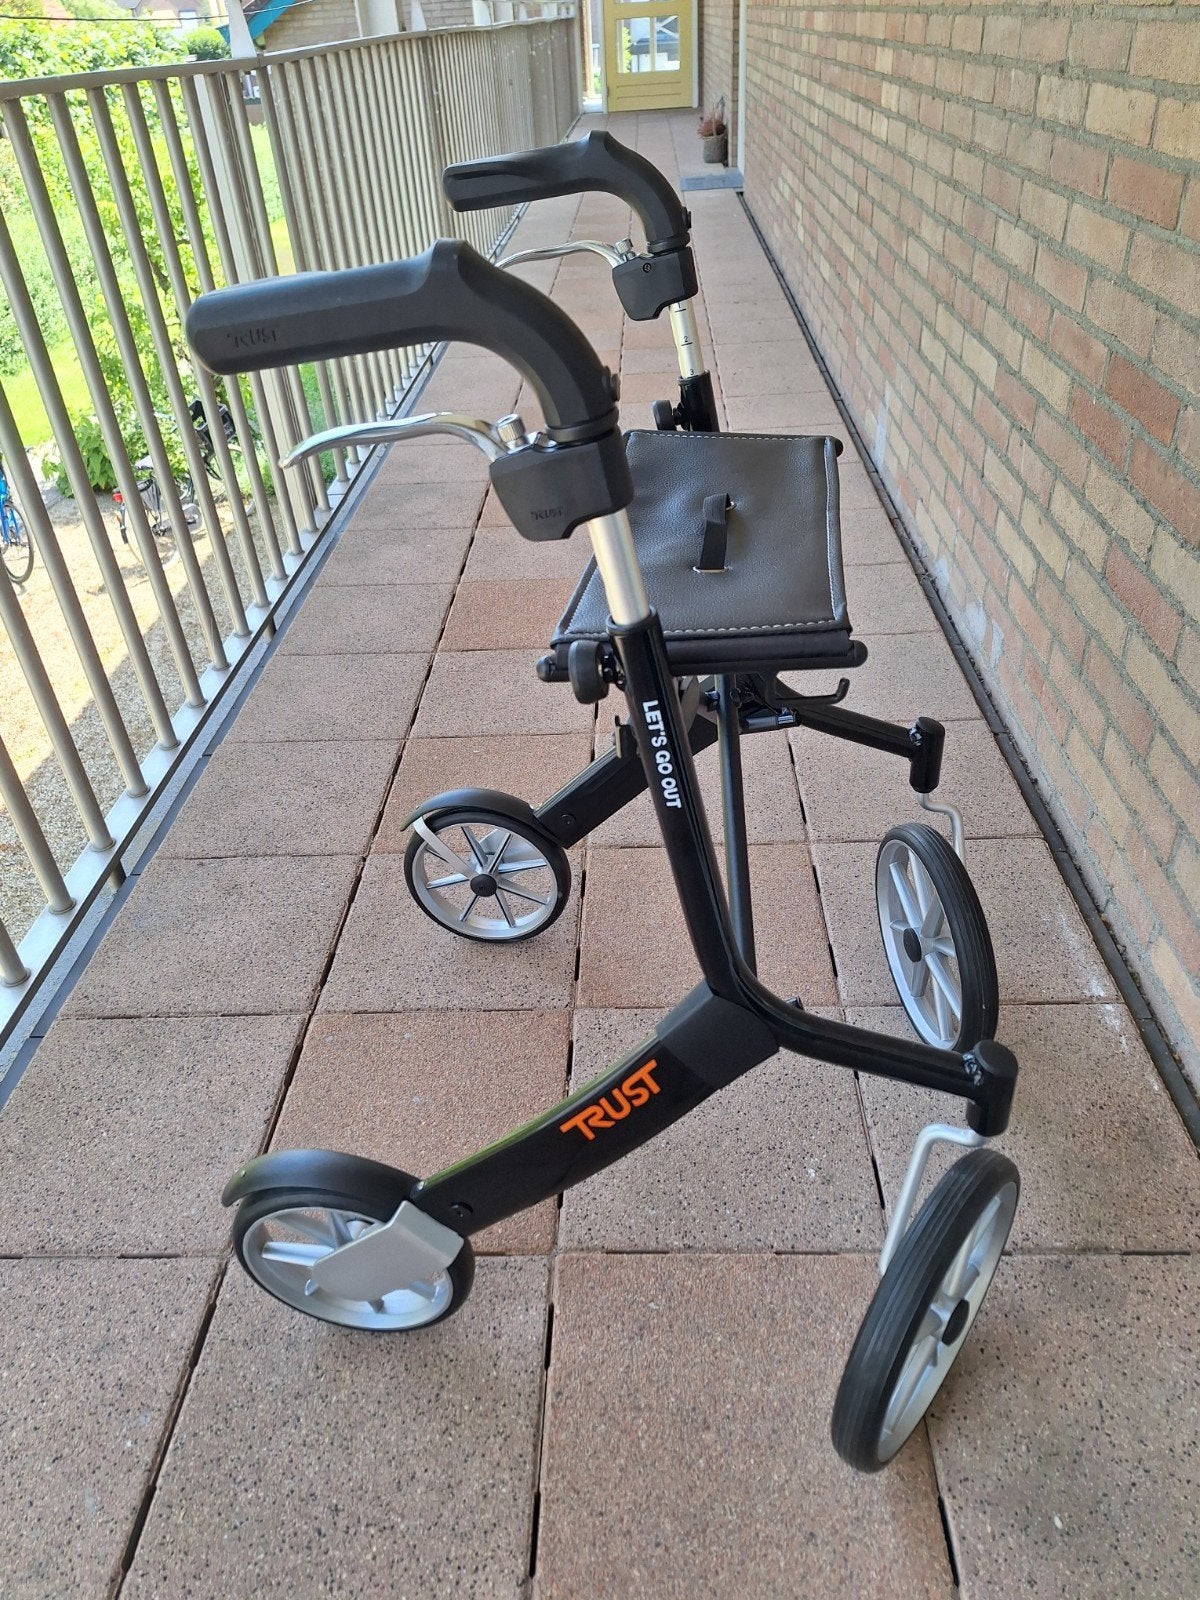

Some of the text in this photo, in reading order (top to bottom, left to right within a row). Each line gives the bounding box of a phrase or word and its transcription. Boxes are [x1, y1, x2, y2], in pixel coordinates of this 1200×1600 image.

[643, 700, 682, 809] LET'S GO OUT
[560, 1059, 661, 1141] TRUST
